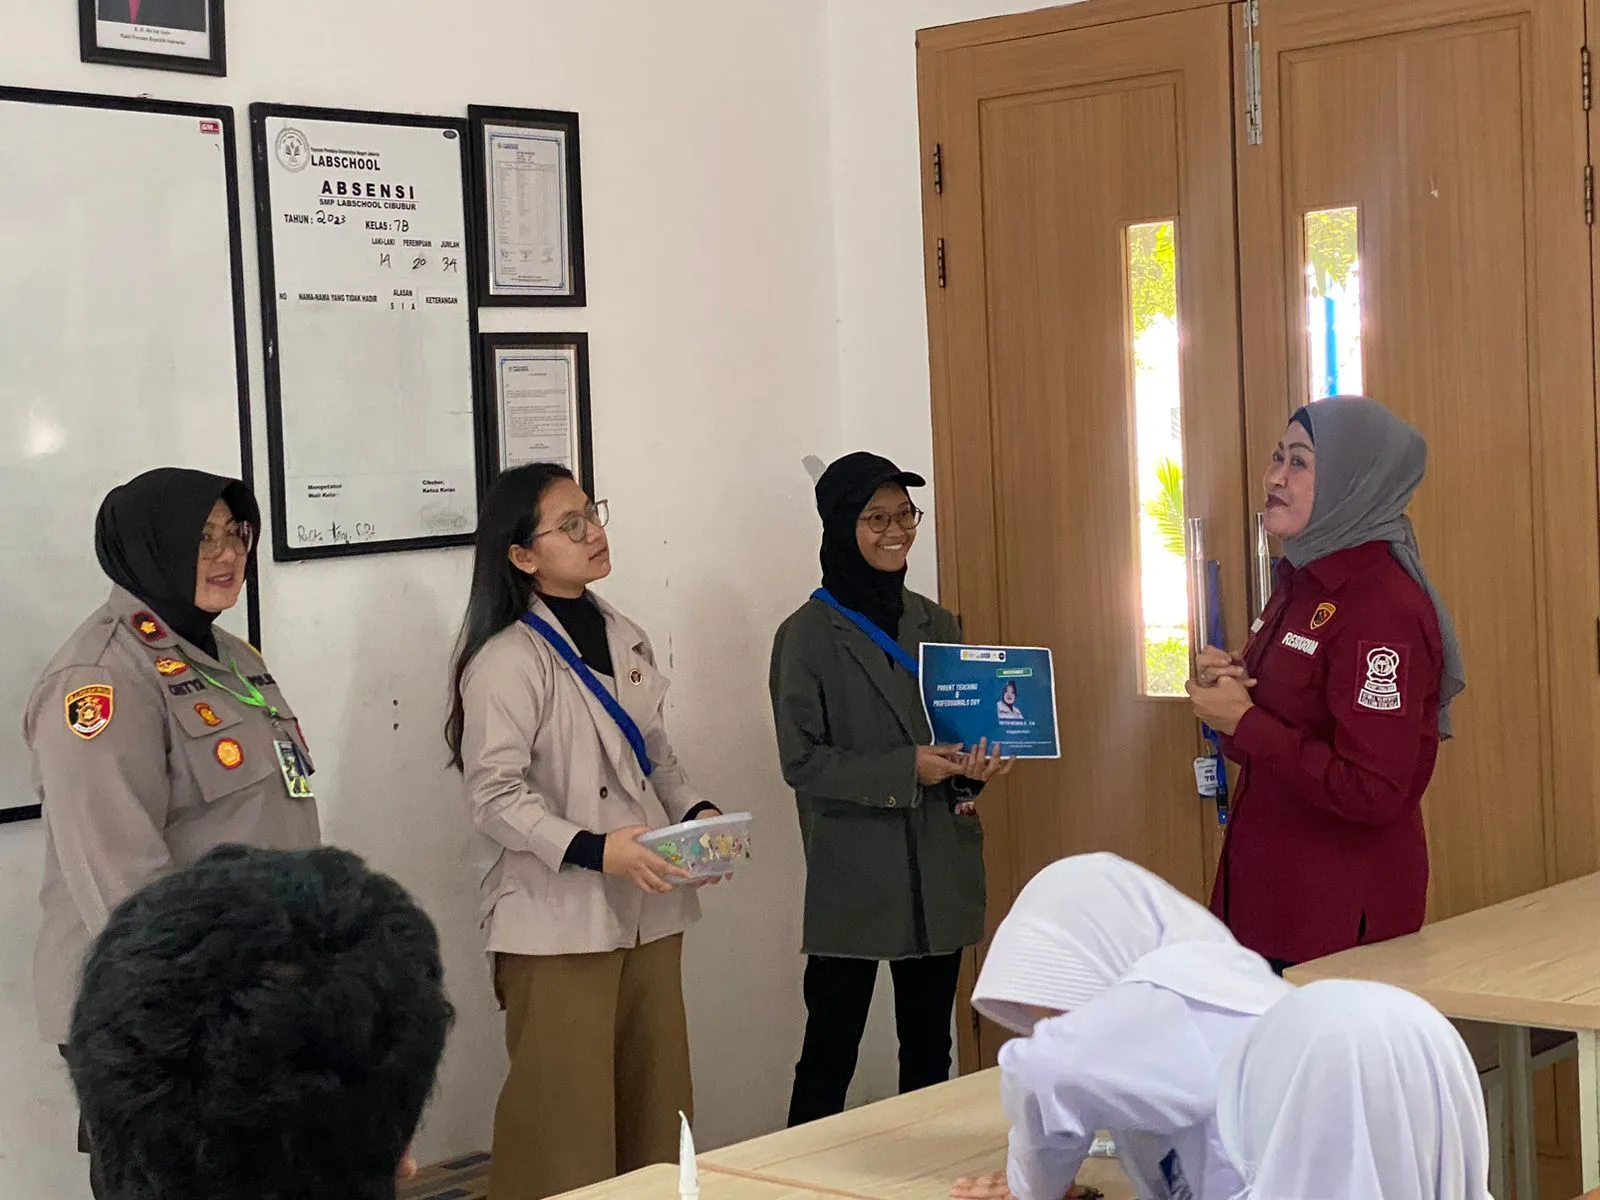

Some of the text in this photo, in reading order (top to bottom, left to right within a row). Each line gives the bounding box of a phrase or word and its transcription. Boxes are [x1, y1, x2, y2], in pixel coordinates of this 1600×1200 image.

[311, 155, 380, 170] LABSCHOOL
[321, 180, 414, 200] ABSENSI
[337, 200, 382, 209] LABSCHOOL
[384, 202, 416, 211] CIBUBUR
[315, 209, 346, 225] 2023
[394, 219, 410, 232] 7B
[371, 238, 396, 246] LAKI-LAKI
[402, 239, 432, 248] PEREMPUAN
[440, 241, 460, 249] JUMLAH
[412, 257, 427, 270] 20
[393, 289, 413, 297] ALASAN
[1282, 632, 1319, 656] RESKRIM
